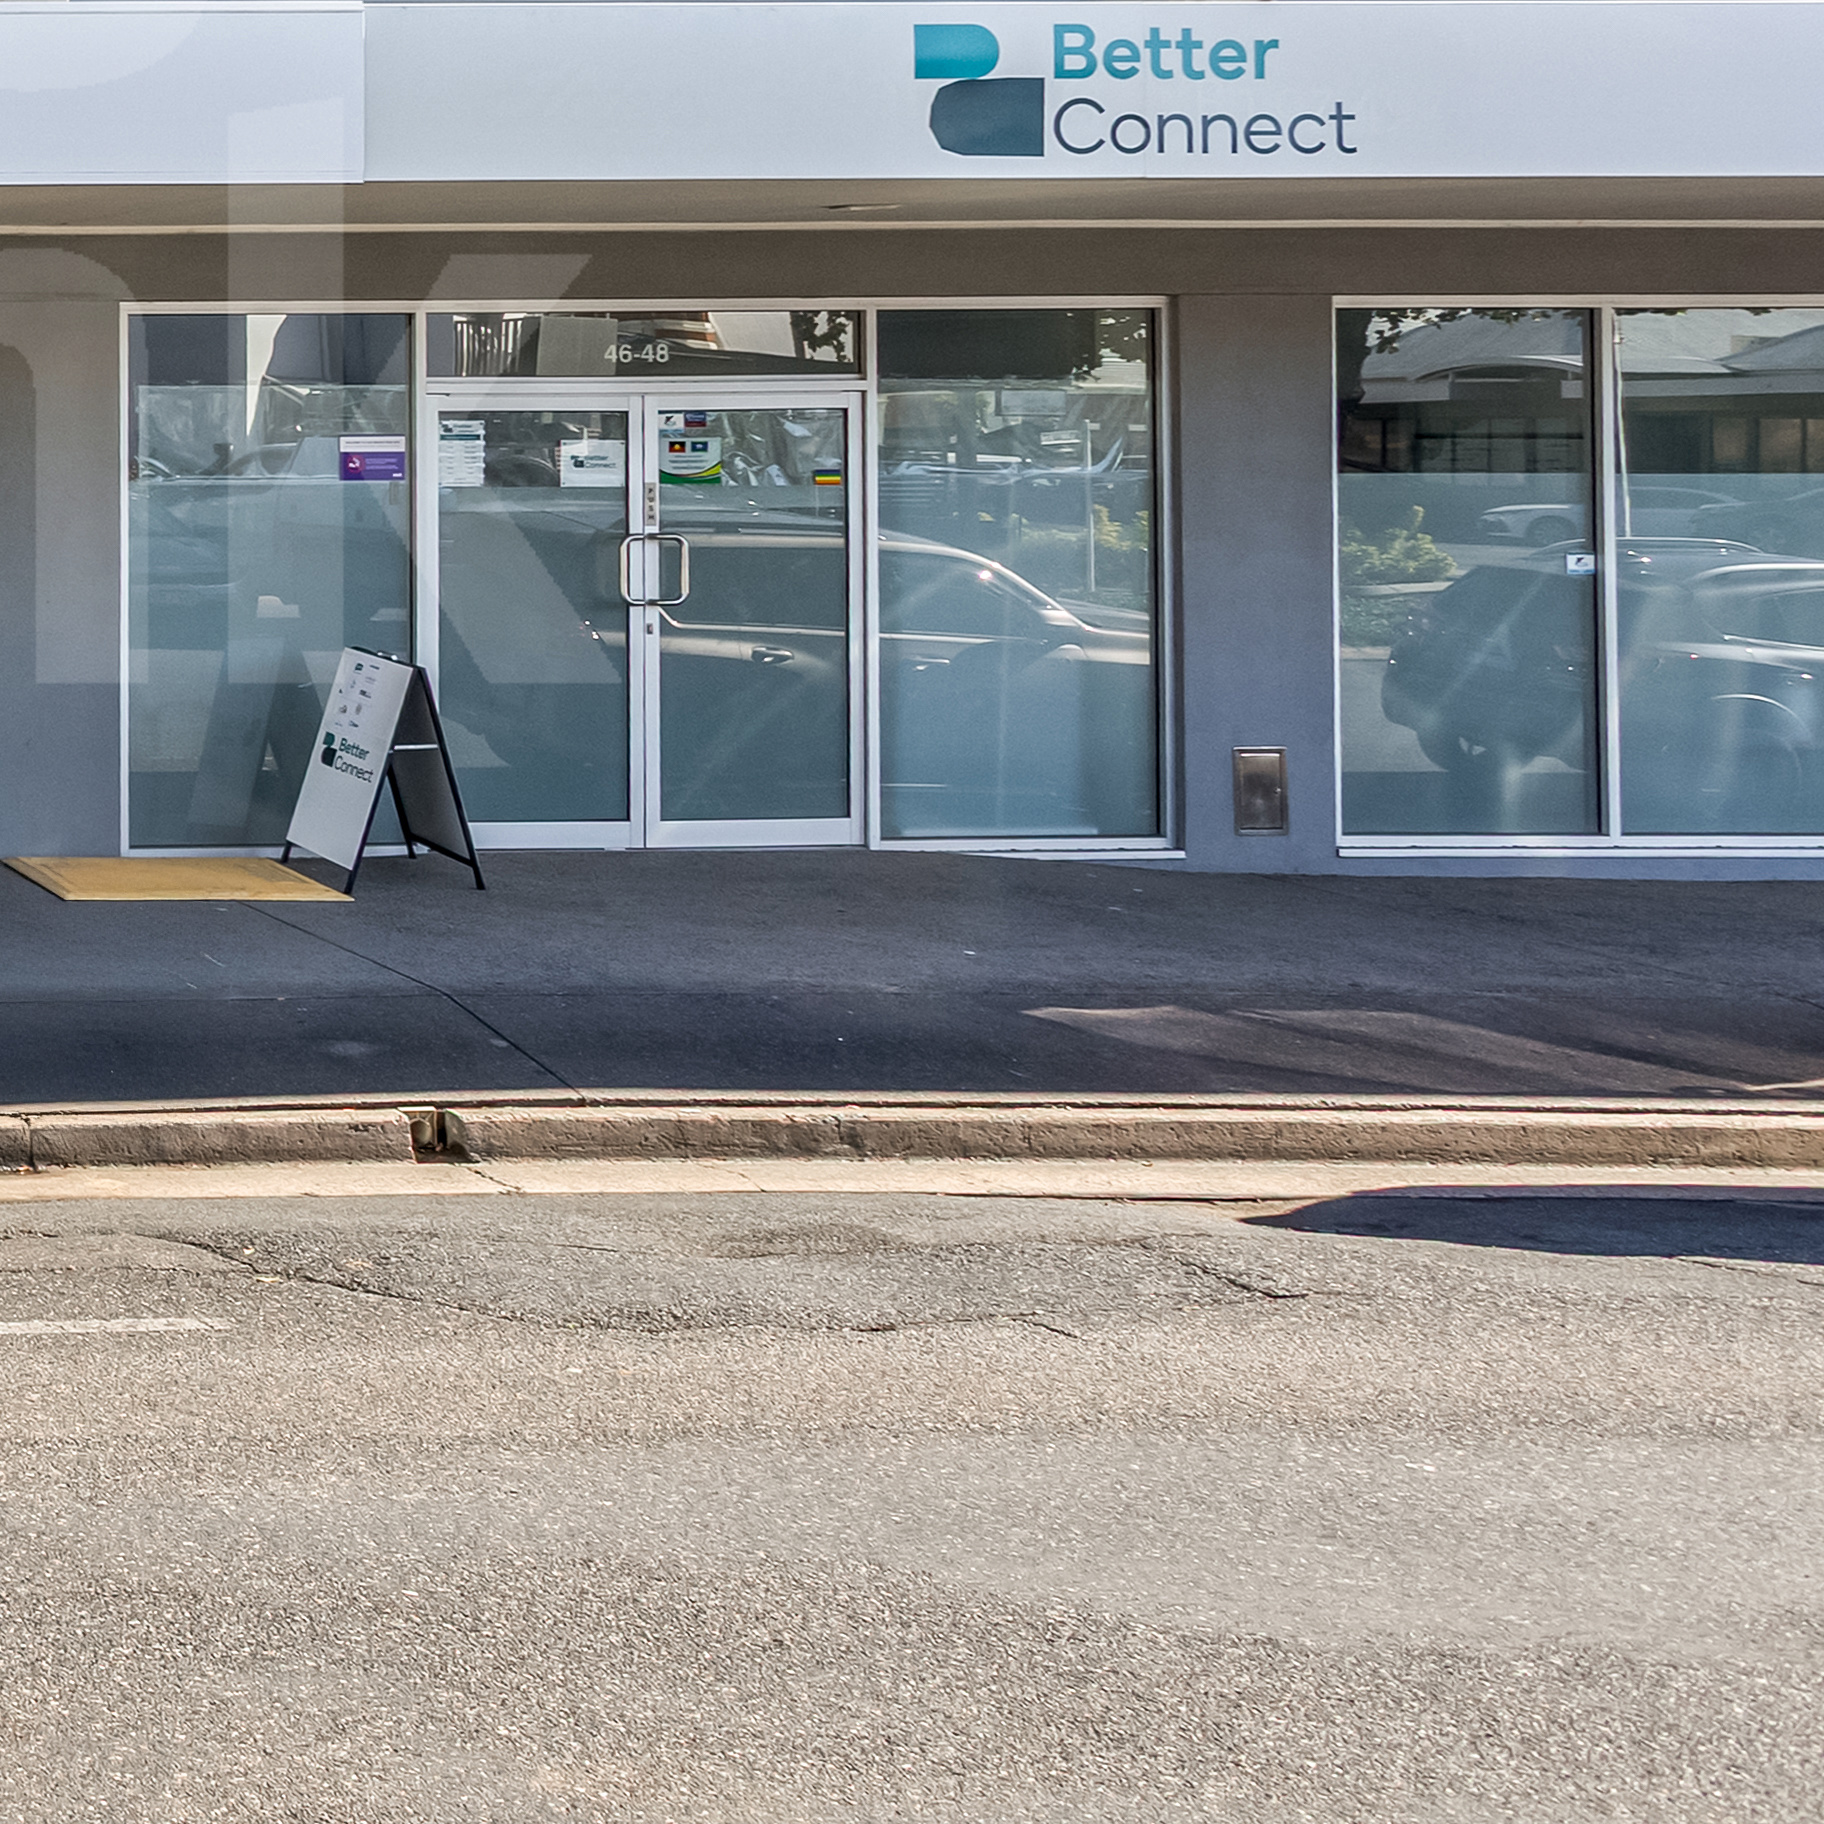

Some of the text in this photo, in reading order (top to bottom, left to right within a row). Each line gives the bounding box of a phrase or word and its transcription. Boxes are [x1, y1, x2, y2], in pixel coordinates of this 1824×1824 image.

[1053, 23, 1279, 80] Better
[1053, 96, 1358, 155] Connect
[604, 344, 670, 363] 46-48
[339, 738, 370, 760] Better
[334, 756, 374, 782] Connect
